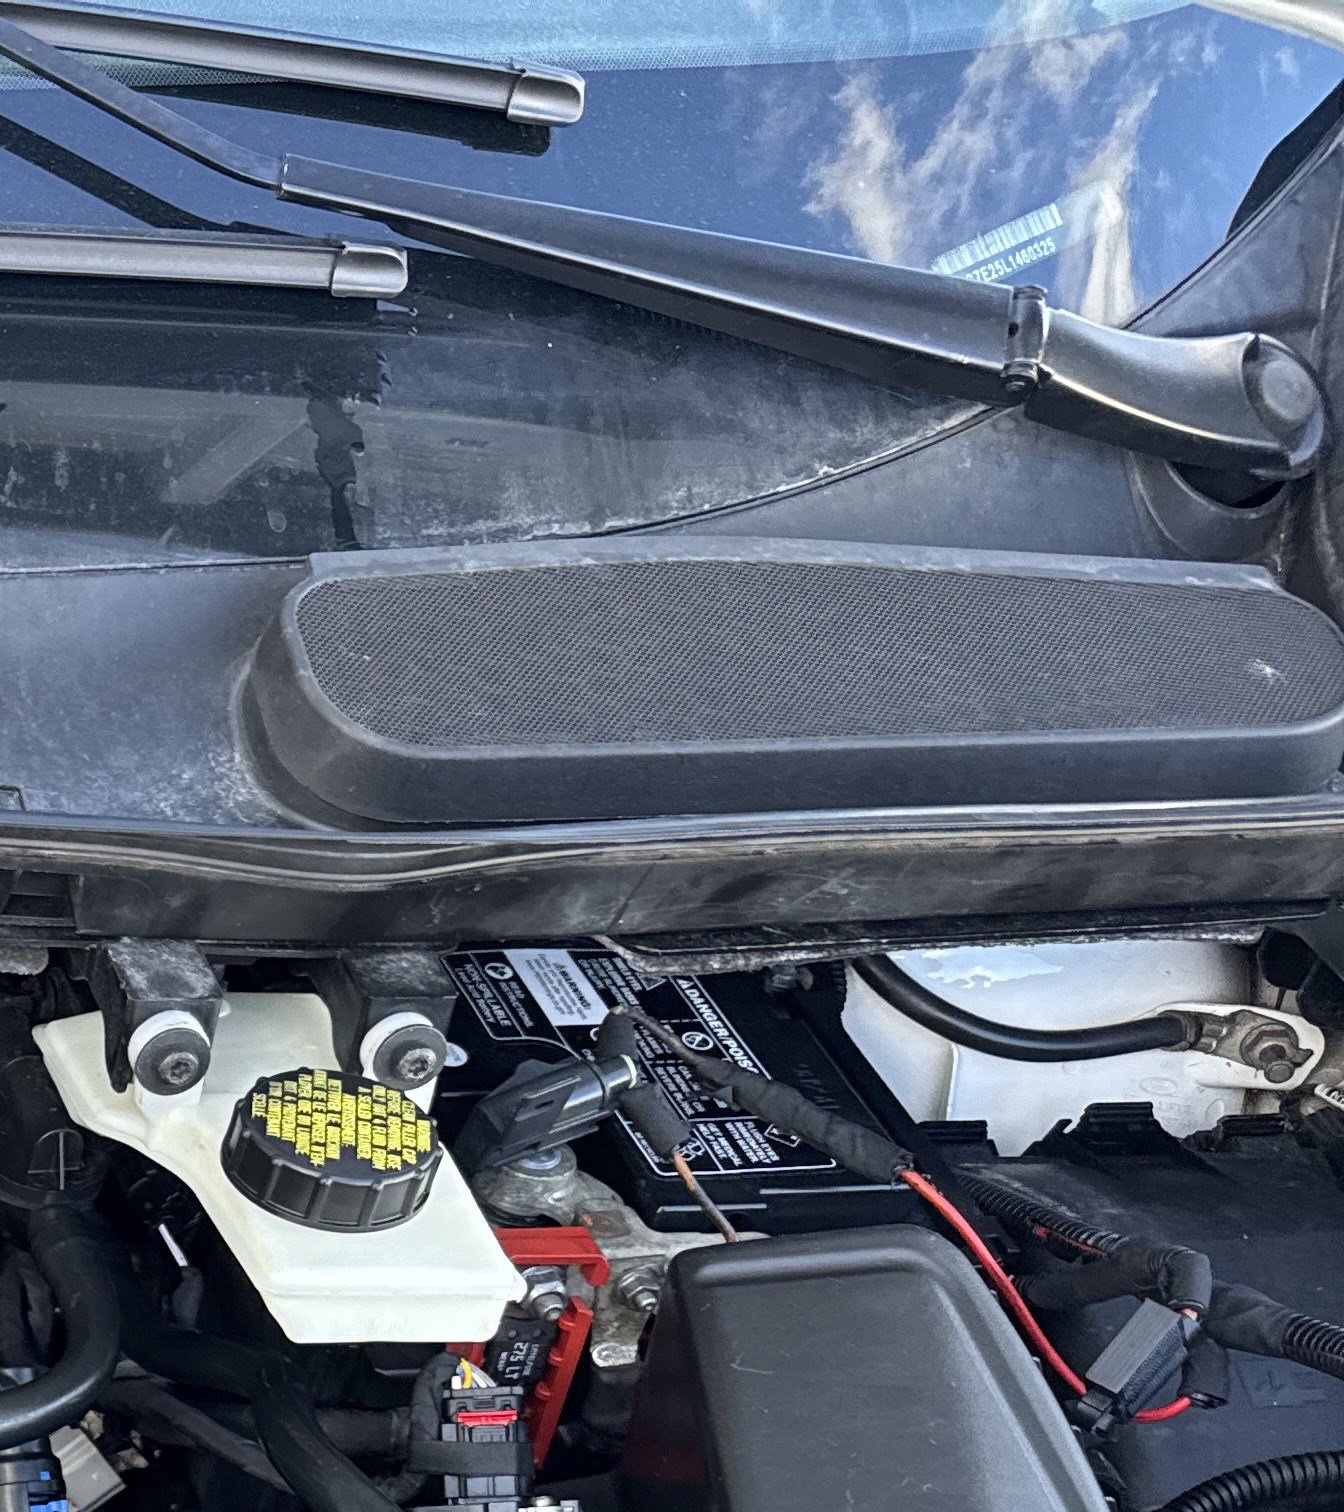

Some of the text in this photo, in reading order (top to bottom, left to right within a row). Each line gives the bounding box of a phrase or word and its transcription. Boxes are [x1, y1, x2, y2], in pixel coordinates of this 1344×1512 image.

[683, 986, 758, 1073] DANGER/POIS
[357, 1095, 371, 1119] SEALED
[402, 1123, 415, 1146] FILLER
[372, 1148, 386, 1170] FROM
[387, 1155, 401, 1170] USE
[402, 1148, 416, 1164] CAP
